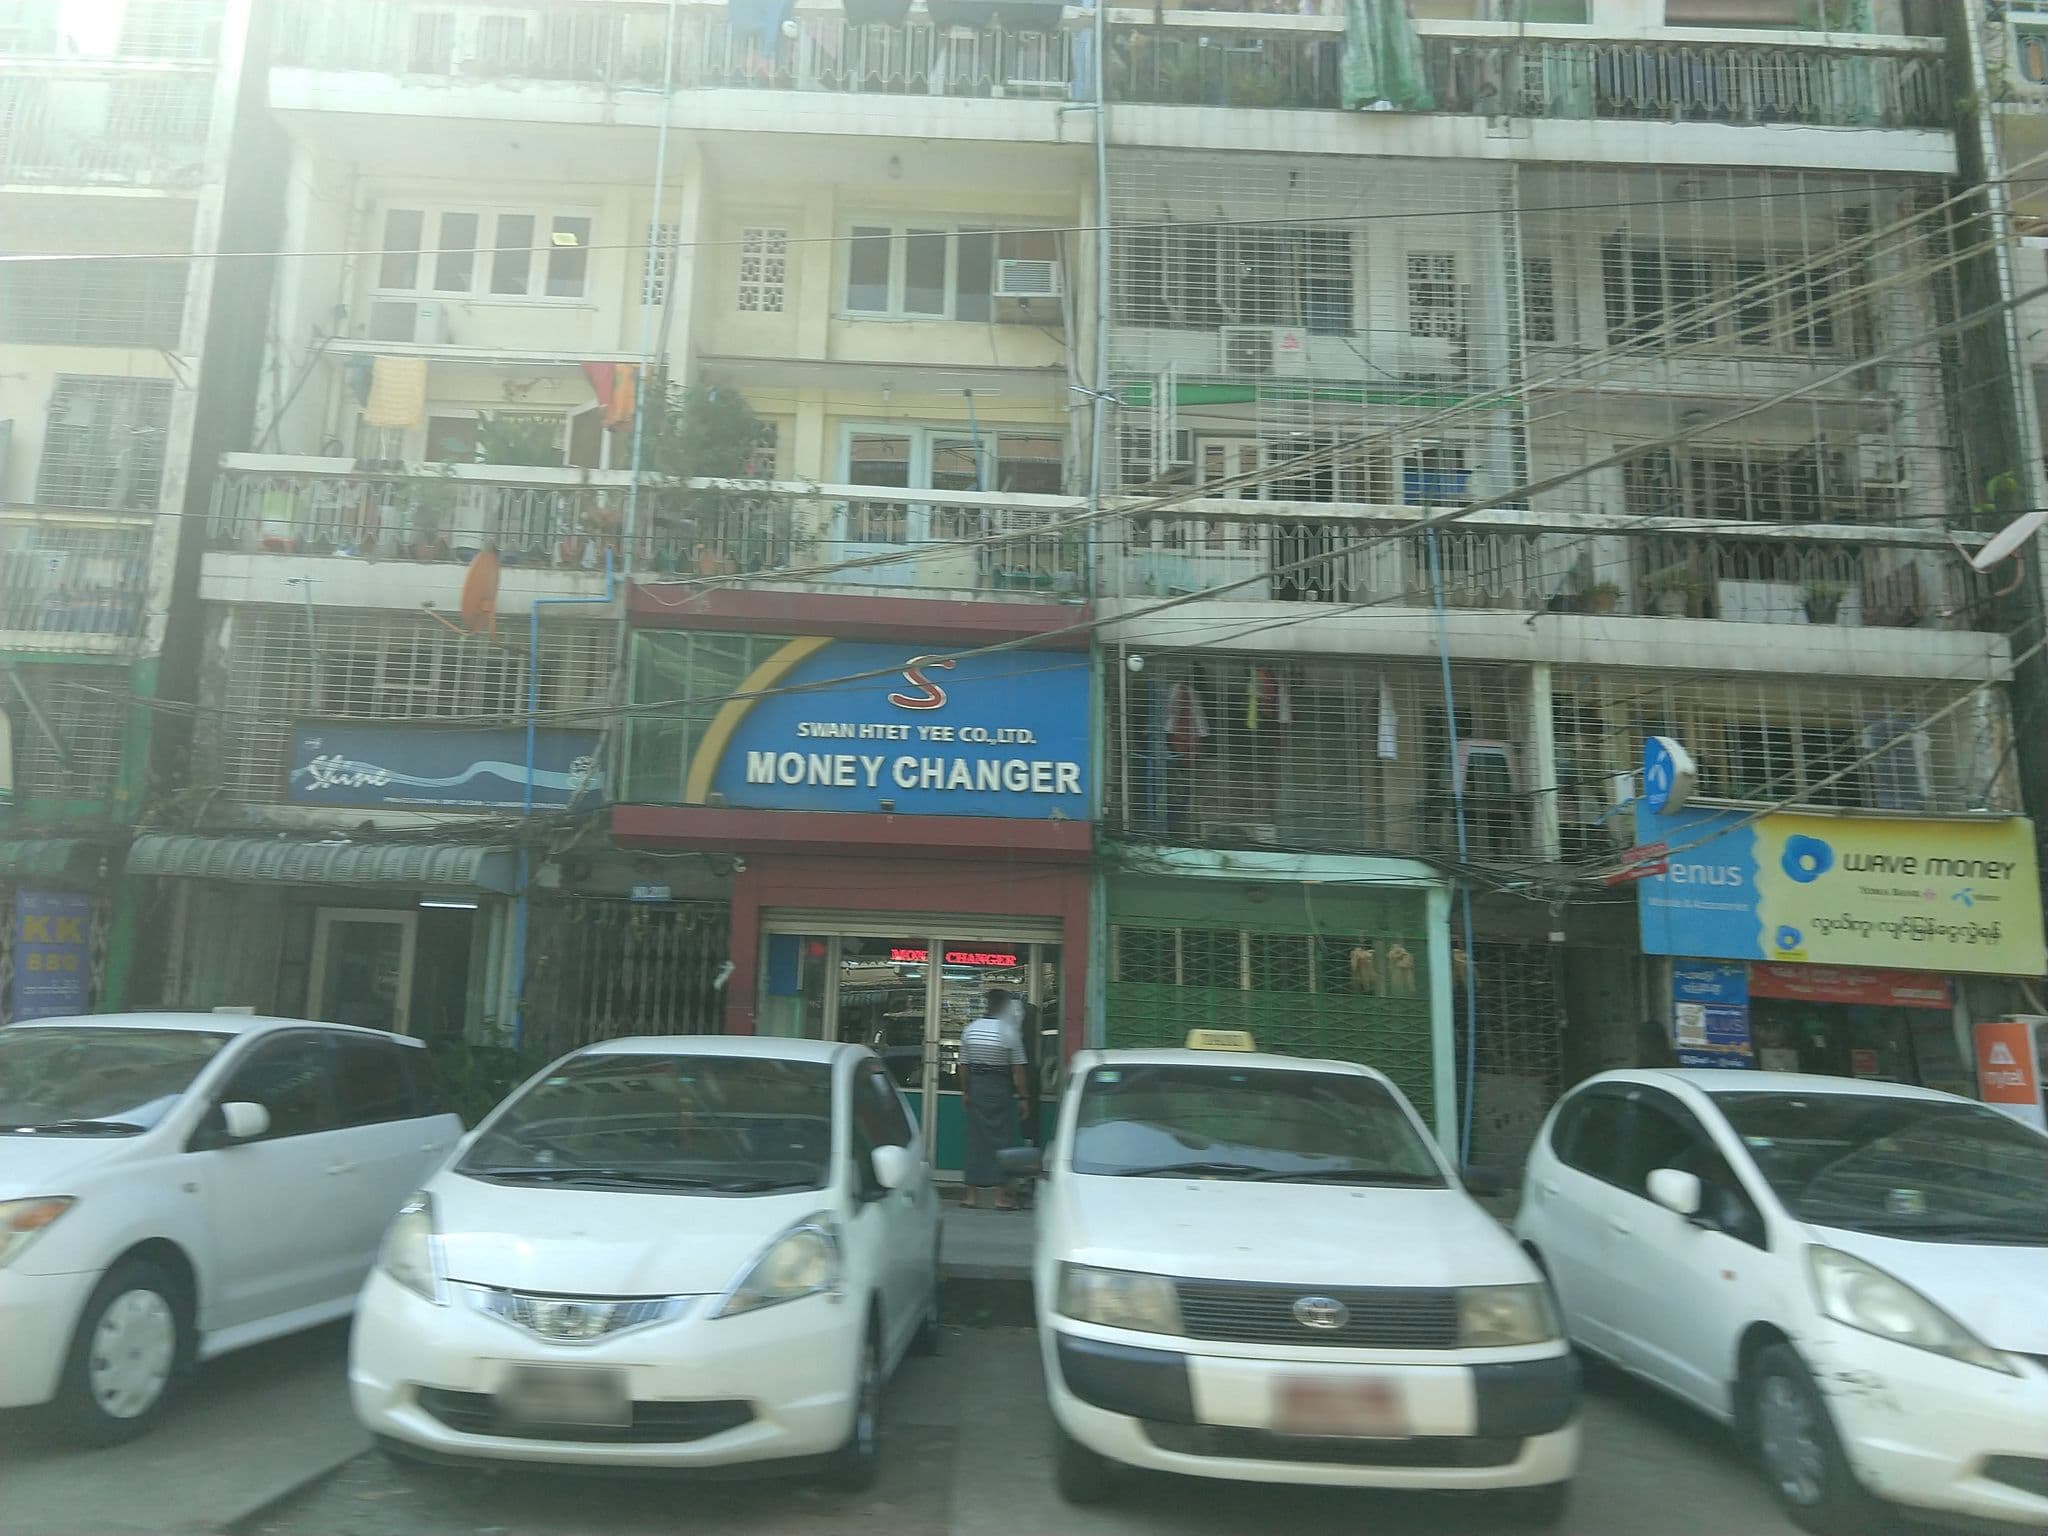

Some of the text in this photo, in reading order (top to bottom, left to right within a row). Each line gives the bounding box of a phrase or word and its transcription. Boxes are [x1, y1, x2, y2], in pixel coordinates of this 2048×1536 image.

[888, 654, 956, 710] S
[797, 722, 856, 739] SWAN
[859, 724, 910, 741] HTET
[917, 726, 955, 742] YEE
[747, 751, 1083, 794] MONEY CHANGER
[1656, 862, 1743, 886] enus
[945, 952, 1018, 967] CHANGER
